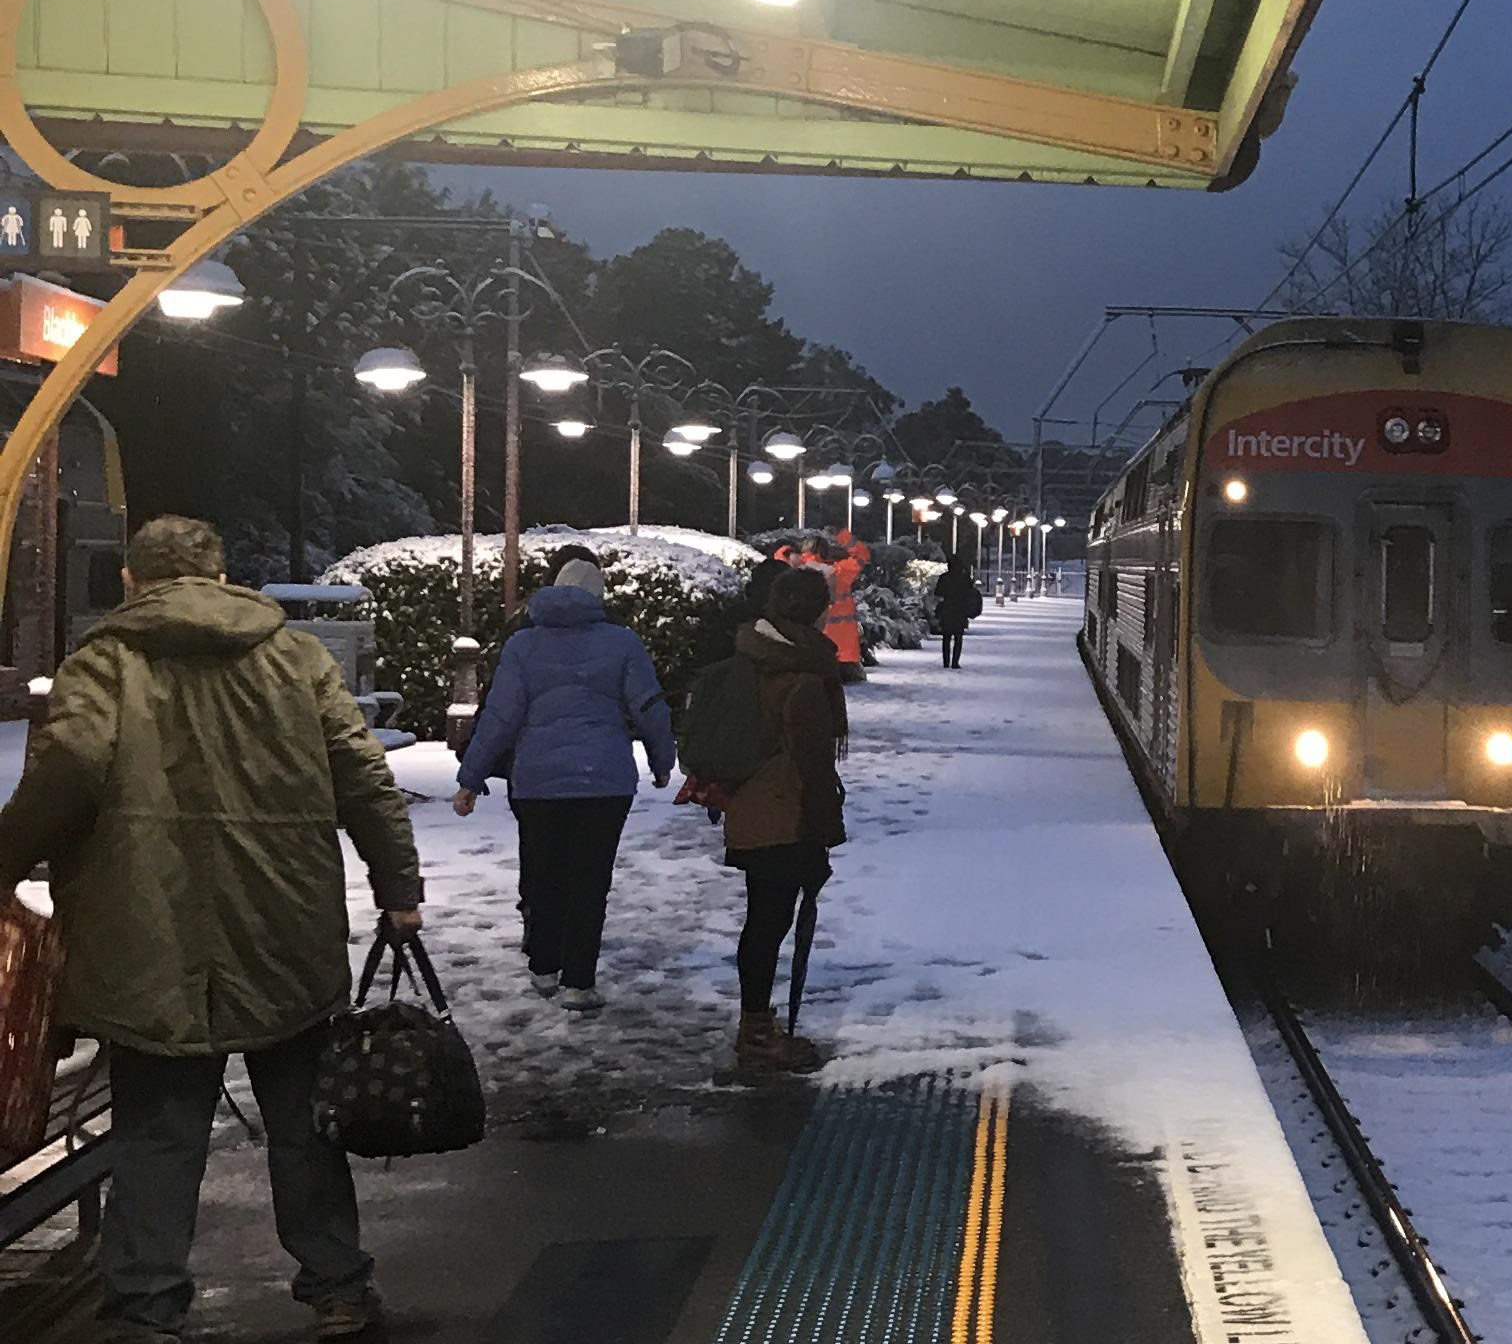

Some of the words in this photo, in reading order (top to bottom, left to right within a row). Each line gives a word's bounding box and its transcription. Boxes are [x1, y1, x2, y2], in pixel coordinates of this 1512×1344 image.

[1227, 429, 1366, 466] Intercity
[1199, 1215, 1268, 1249] THE
[1206, 1248, 1293, 1325] YELLOW
